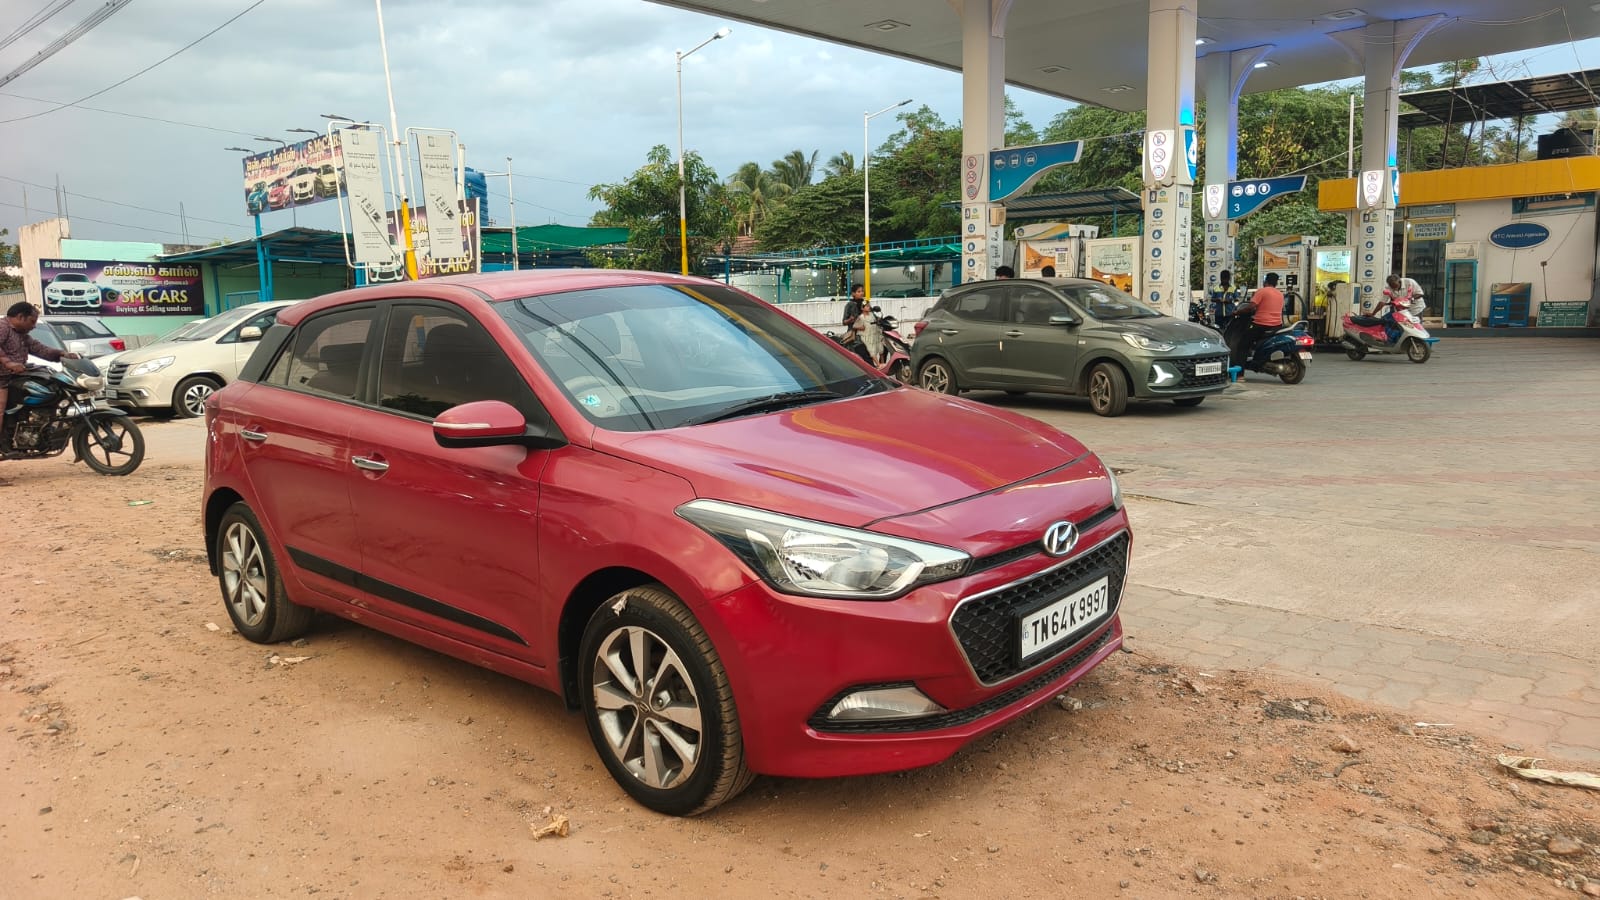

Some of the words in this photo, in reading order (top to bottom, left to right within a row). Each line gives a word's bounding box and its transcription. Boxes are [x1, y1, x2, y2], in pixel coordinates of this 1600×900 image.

[996, 179, 1001, 191] 1
[1233, 203, 1241, 212] 3
[158, 265, 199, 277] கார்ஸ்
[121, 290, 145, 303] SM
[148, 290, 189, 304] CARS
[116, 305, 138, 314] Buying
[145, 305, 166, 313] Selling
[1032, 585, 1106, 645] TN64K9997
